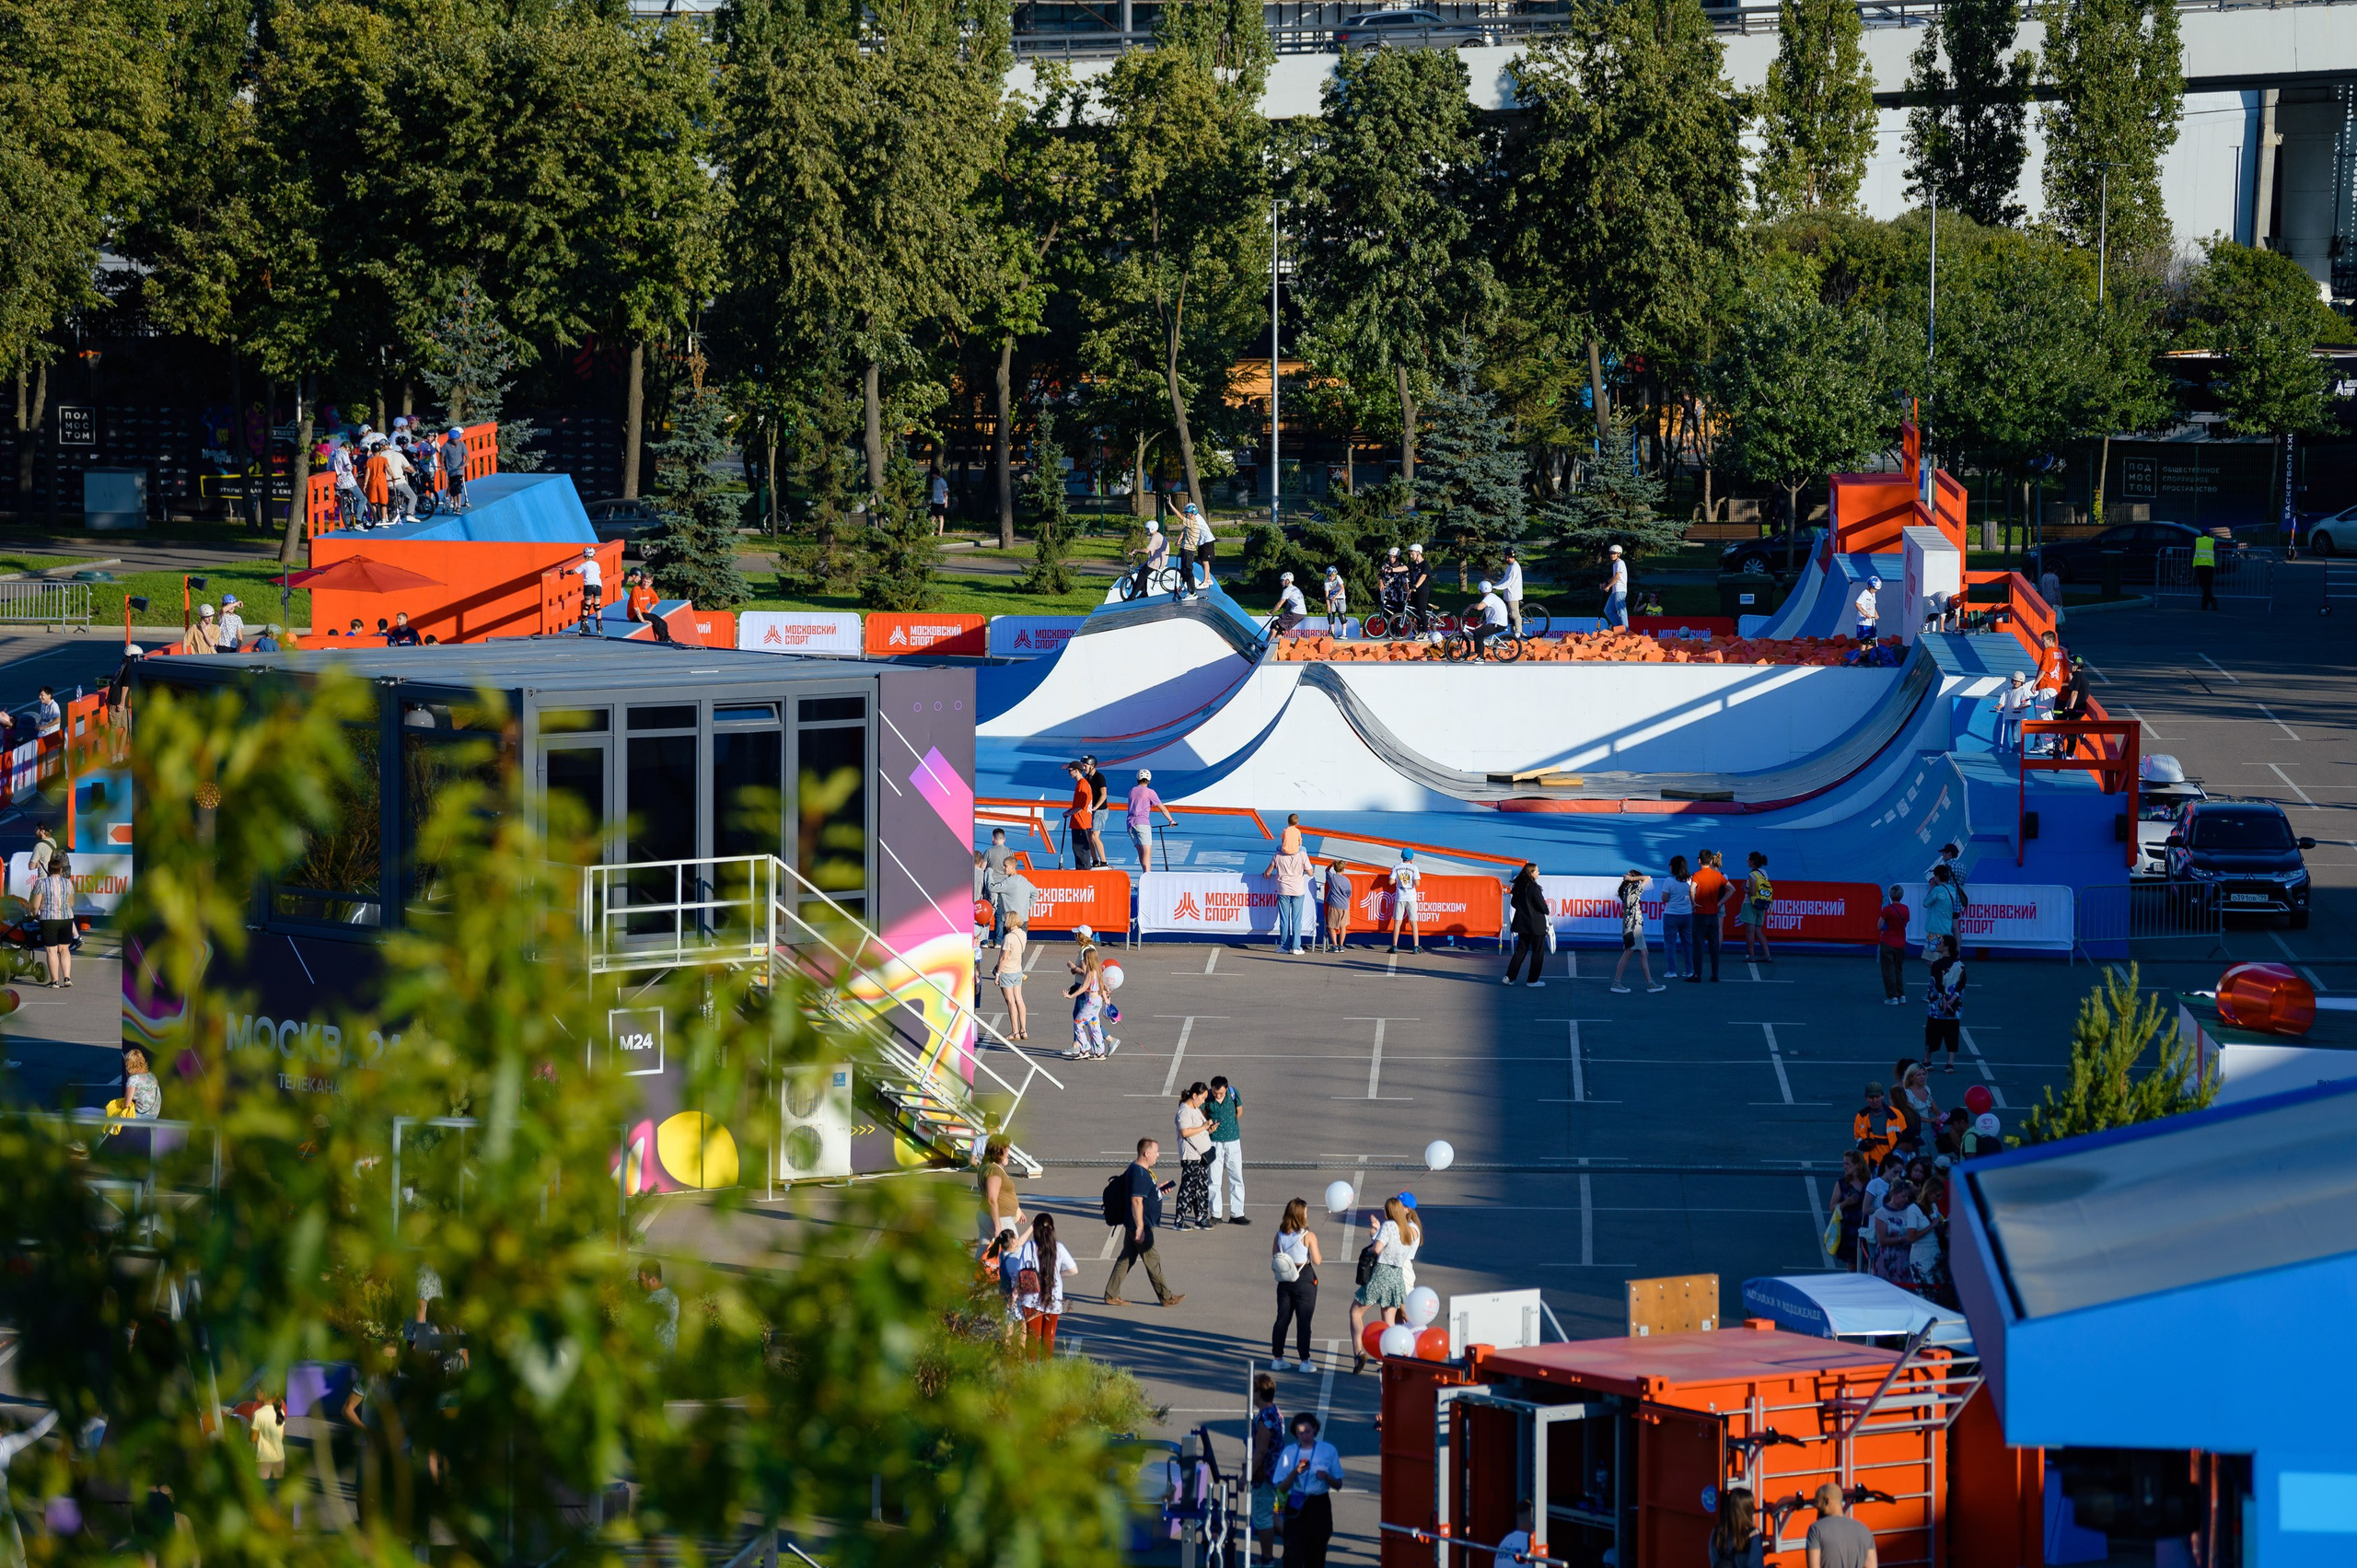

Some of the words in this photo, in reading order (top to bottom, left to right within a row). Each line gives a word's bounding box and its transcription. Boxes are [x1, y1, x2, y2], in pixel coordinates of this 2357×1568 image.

[64, 412, 89, 421] ПОД
[64, 422, 89, 430] МОС
[65, 431, 90, 439] ТОМ
[2129, 462, 2152, 472] ПОД
[2162, 466, 2221, 474] ОБЩЕСТВЕННОЕ
[2129, 473, 2152, 482] МОС
[2162, 475, 2210, 483] СПОРТИВНОЕ
[2129, 483, 2152, 492] ТОМ
[2284, 454, 2293, 519] БАСКЕТБОЛ
[784, 623, 837, 635] МОСКОВСКИЙ
[910, 624, 962, 636] МОСКОВСКИЙ
[1035, 629, 1076, 639] МОСКОВС
[1283, 629, 1330, 638] МОСКОВСКИ
[1658, 627, 1712, 639] МОСКСКИЙ
[784, 635, 809, 645] СПОРТ
[910, 635, 935, 646] СПОРТ
[1035, 639, 1060, 649] СПОРТ
[1037, 885, 1095, 902] СКОВСКИЙ
[1417, 891, 1426, 901] ЕТ
[1417, 902, 1467, 912] ОСКОВСКОМУ
[1767, 898, 1845, 916] МОСКОВСКИЙ
[1958, 901, 2038, 919] МОСКОВСКИЙ
[1204, 907, 1241, 922] СПОРТ
[1417, 912, 1441, 923] ПОРТУ
[1766, 914, 1804, 930] СПОРТ
[1958, 919, 1995, 934] СПОРТ
[619, 1033, 654, 1051] М24
[277, 1073, 342, 1096] ТЕЛЕКАНА
